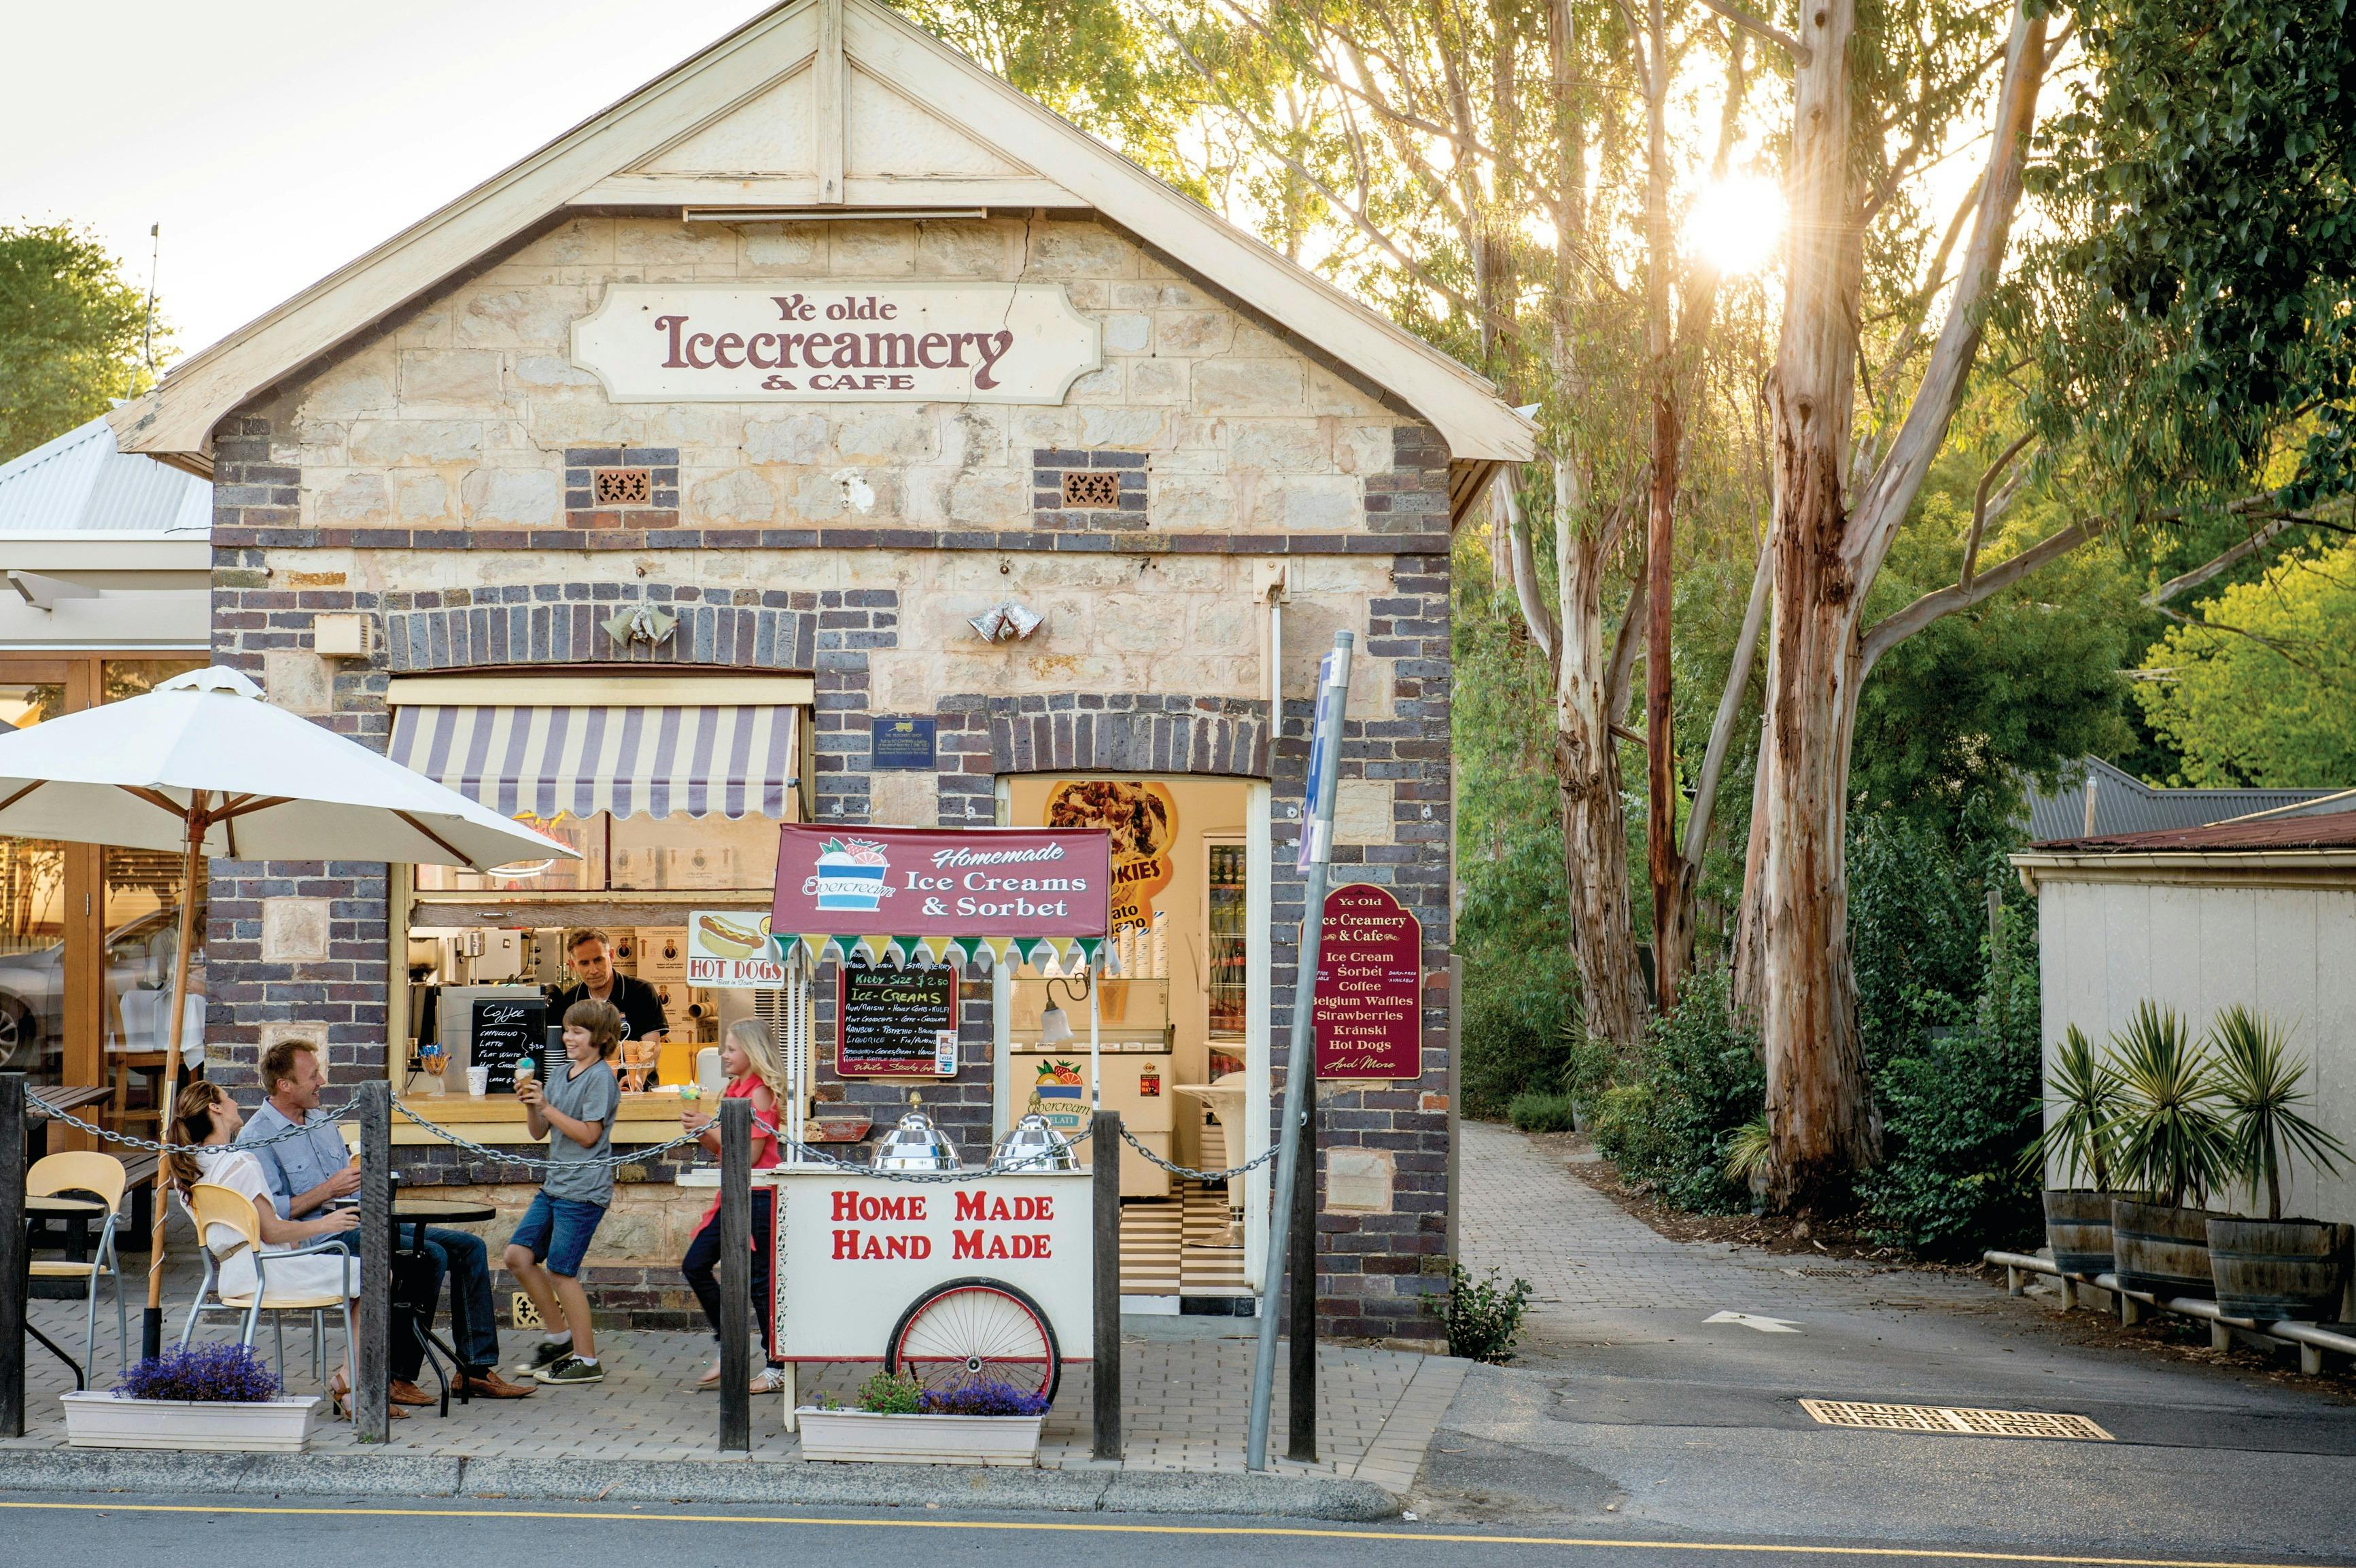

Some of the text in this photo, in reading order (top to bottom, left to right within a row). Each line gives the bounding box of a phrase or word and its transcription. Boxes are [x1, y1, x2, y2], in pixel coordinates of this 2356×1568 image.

[770, 294, 897, 320] Ye olde
[655, 316, 1014, 391] Icecreamery
[761, 374, 915, 390] & CAFE
[930, 842, 1065, 869] Homemade
[1111, 859, 1160, 884] KIES
[802, 875, 897, 898] Evercream
[904, 871, 1087, 892] Ice Creams
[922, 896, 1068, 917] & Sorbet
[1338, 898, 1382, 906] Ye Old
[1112, 905, 1139, 920] ato
[1322, 913, 1406, 928] ce Creamery
[1339, 929, 1384, 941] & Cafe
[1326, 952, 1393, 962] Ice Cream
[691, 960, 782, 979] HOT DOGS
[1337, 966, 1382, 976] Sorbet
[855, 973, 884, 984] KIDDY
[890, 975, 913, 985] SIZE
[1338, 981, 1381, 991] Coffee
[846, 1003, 884, 1012] RUM/RAISIN
[1365, 996, 1413, 1006] Waffles
[483, 1004, 525, 1024] Coffee
[1317, 1011, 1403, 1020] Strawberries
[846, 1024, 874, 1033] RAINBOW
[882, 1025, 912, 1034] PISTACHIO
[846, 1035, 885, 1044] LIQUORICE
[1329, 1040, 1391, 1053] Hot Dogs
[479, 1049, 498, 1058] FLAT
[853, 1062, 882, 1071] While
[1324, 1056, 1396, 1071] And More
[831, 1191, 1054, 1221] HOME MADE
[831, 1229, 1052, 1259] HAND MADE
